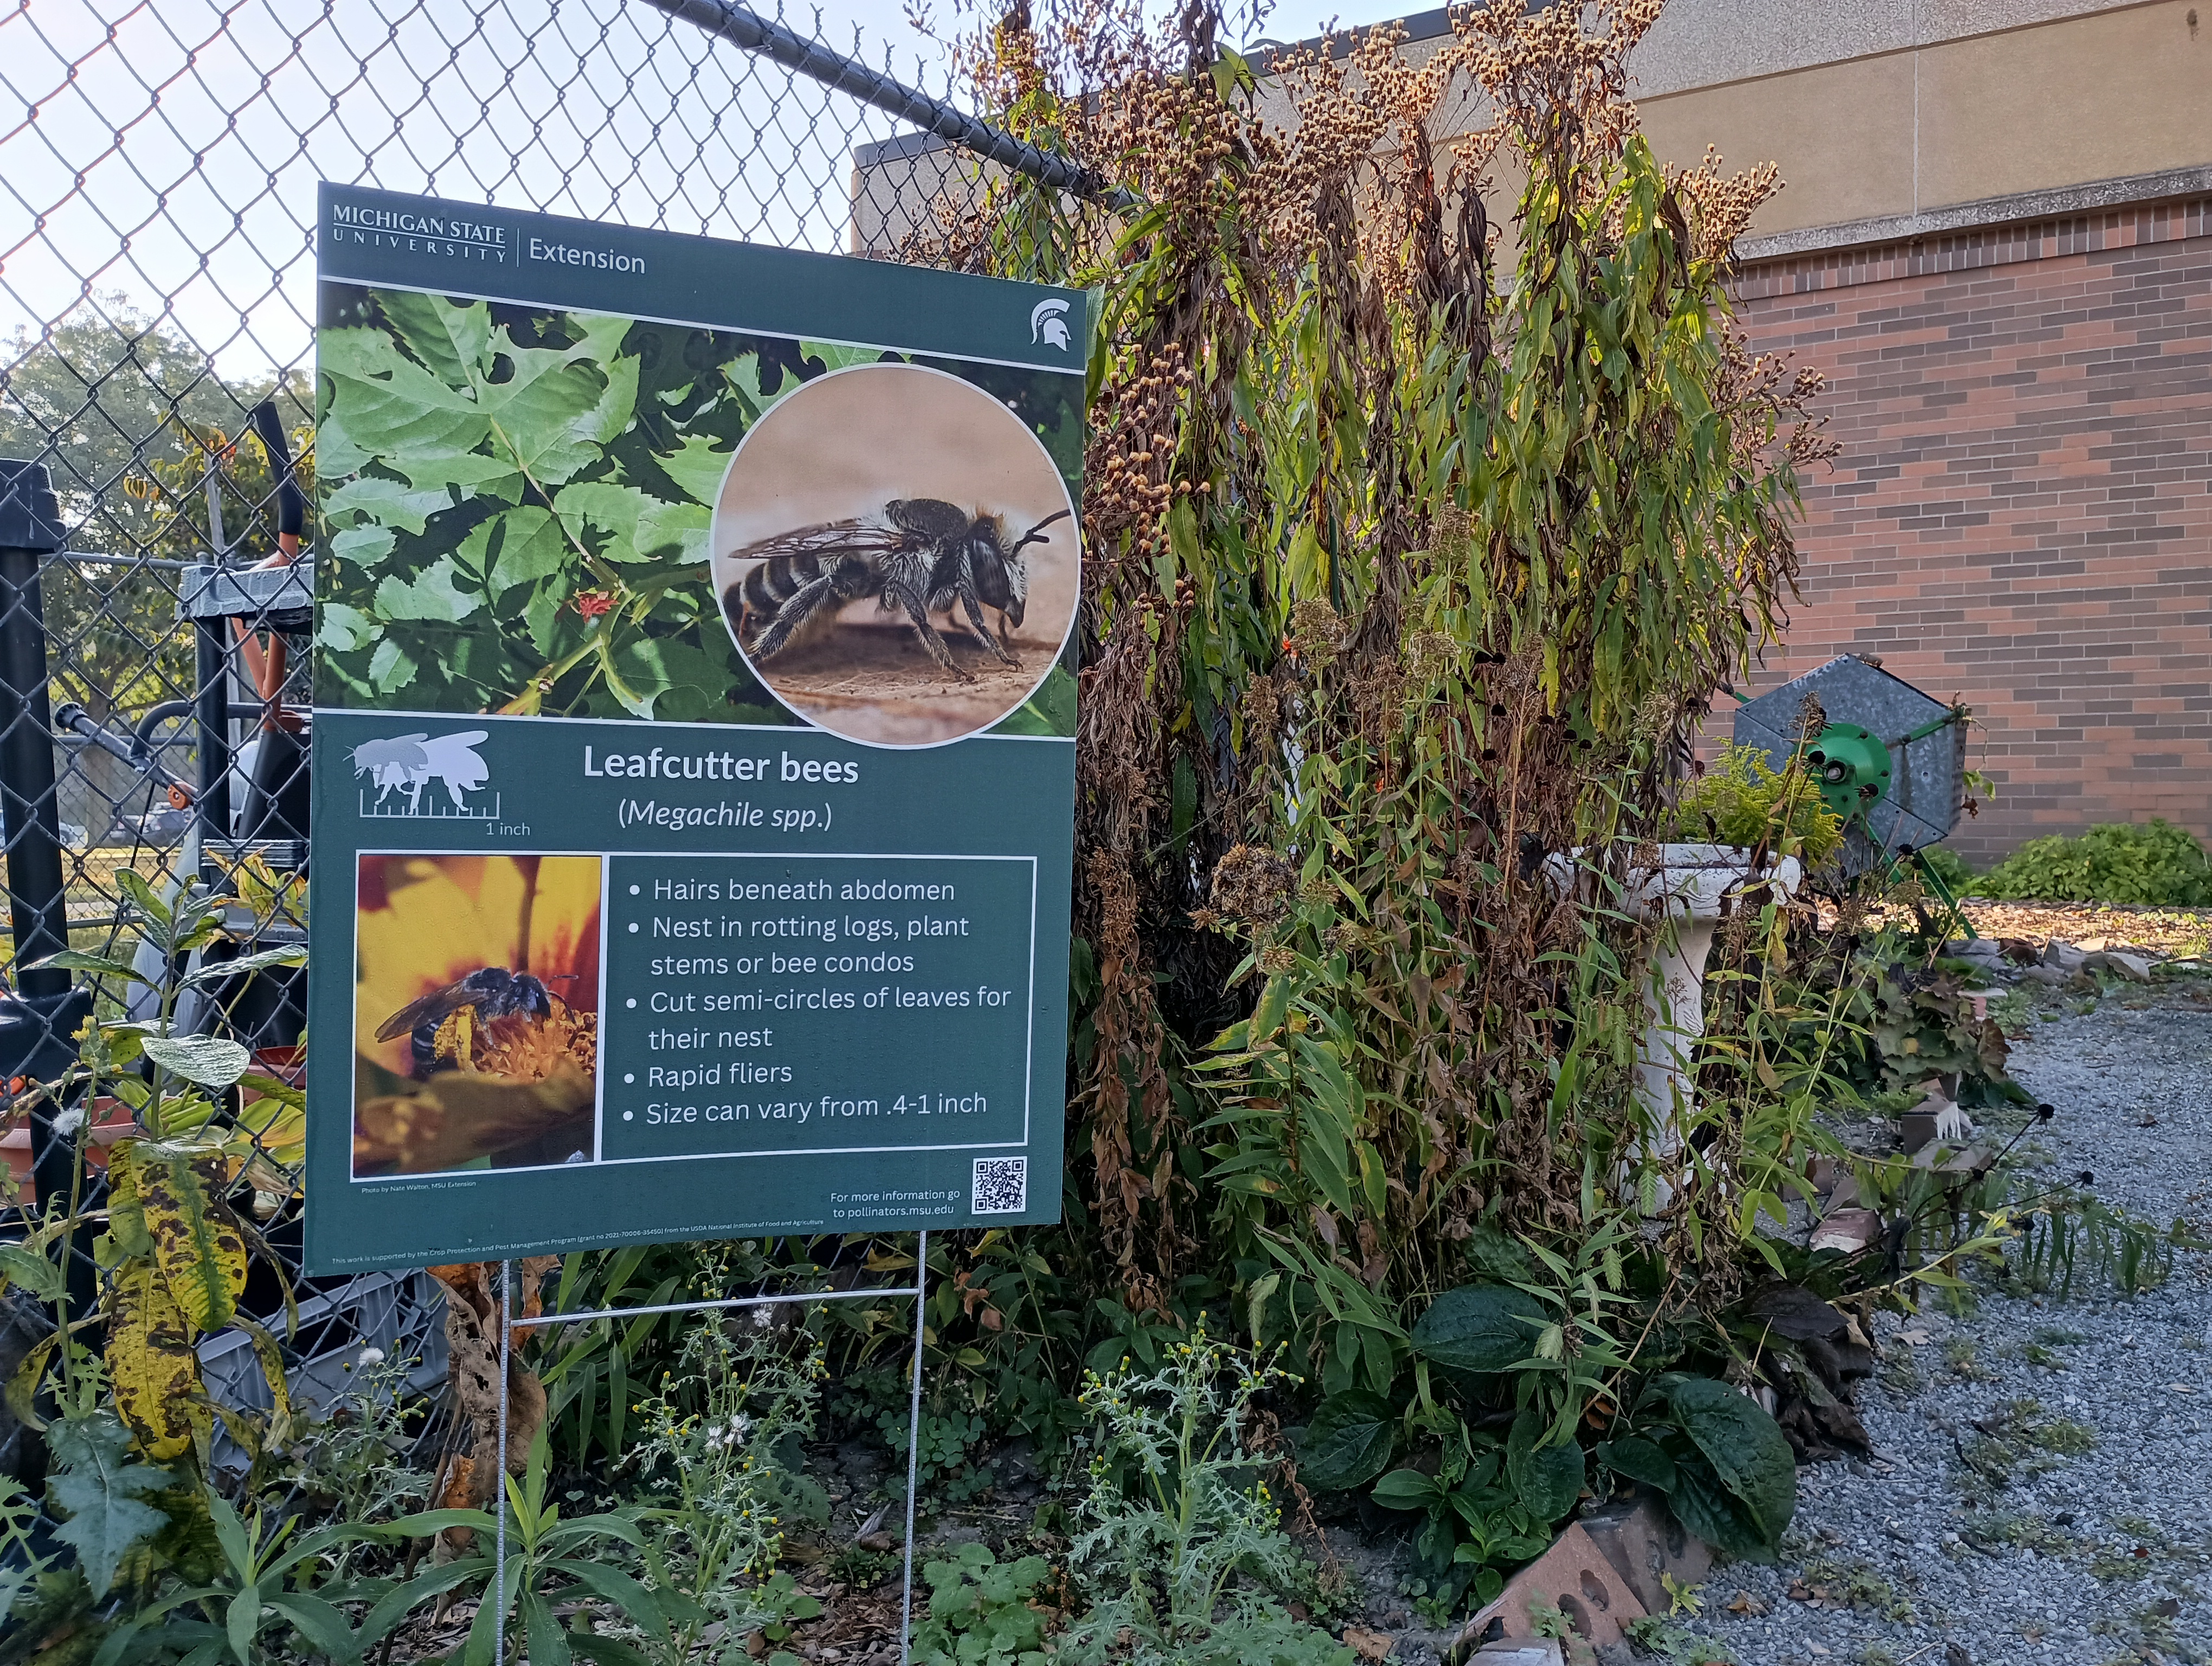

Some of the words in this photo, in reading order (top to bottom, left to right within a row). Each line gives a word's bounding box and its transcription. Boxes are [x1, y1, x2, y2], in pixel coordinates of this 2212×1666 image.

[333, 204, 443, 235] MICHIGAN
[450, 221, 506, 244] STATE
[333, 229, 506, 262] UNIVERSITY
[530, 238, 645, 273] Extension
[585, 746, 770, 780] Leafcutter
[781, 751, 858, 783] bees
[619, 799, 763, 830] (Megachile
[771, 803, 831, 832] spp.)
[487, 823, 494, 835] 1
[500, 823, 530, 835] inch
[655, 879, 719, 899] Hairs
[730, 879, 832, 899] beneath
[841, 879, 954, 900] abdomen
[654, 917, 712, 937] Nest
[722, 916, 741, 936] in
[752, 915, 836, 941] rotting
[845, 915, 898, 941] logs,
[908, 915, 969, 941] plant
[651, 956, 728, 975] stems
[737, 958, 763, 973] or
[772, 952, 816, 973] bee
[825, 951, 914, 972] condos
[651, 992, 696, 1012] Cut
[704, 988, 854, 1011] semi-circles
[864, 987, 889, 1008] of
[896, 987, 969, 1007] leaves
[978, 986, 1011, 1006] for
[648, 1028, 710, 1049] their
[719, 1028, 773, 1047] nest
[650, 1063, 720, 1091] Rapid
[729, 1062, 792, 1084] fliers
[647, 1103, 697, 1124] Size
[706, 1105, 748, 1121] can
[758, 1103, 812, 1123] vary
[820, 1096, 877, 1117] from
[888, 1095, 930, 1114] .4-1
[939, 1092, 986, 1113] inch
[831, 1193, 848, 1202] For
[883, 1190, 944, 1200] information
[948, 1191, 960, 1201] go
[833, 1209, 844, 1218] to
[848, 1204, 954, 1219] pollinators.msu.edu
[372, 1252, 406, 1261] supported
[510, 1240, 550, 1249] Management
